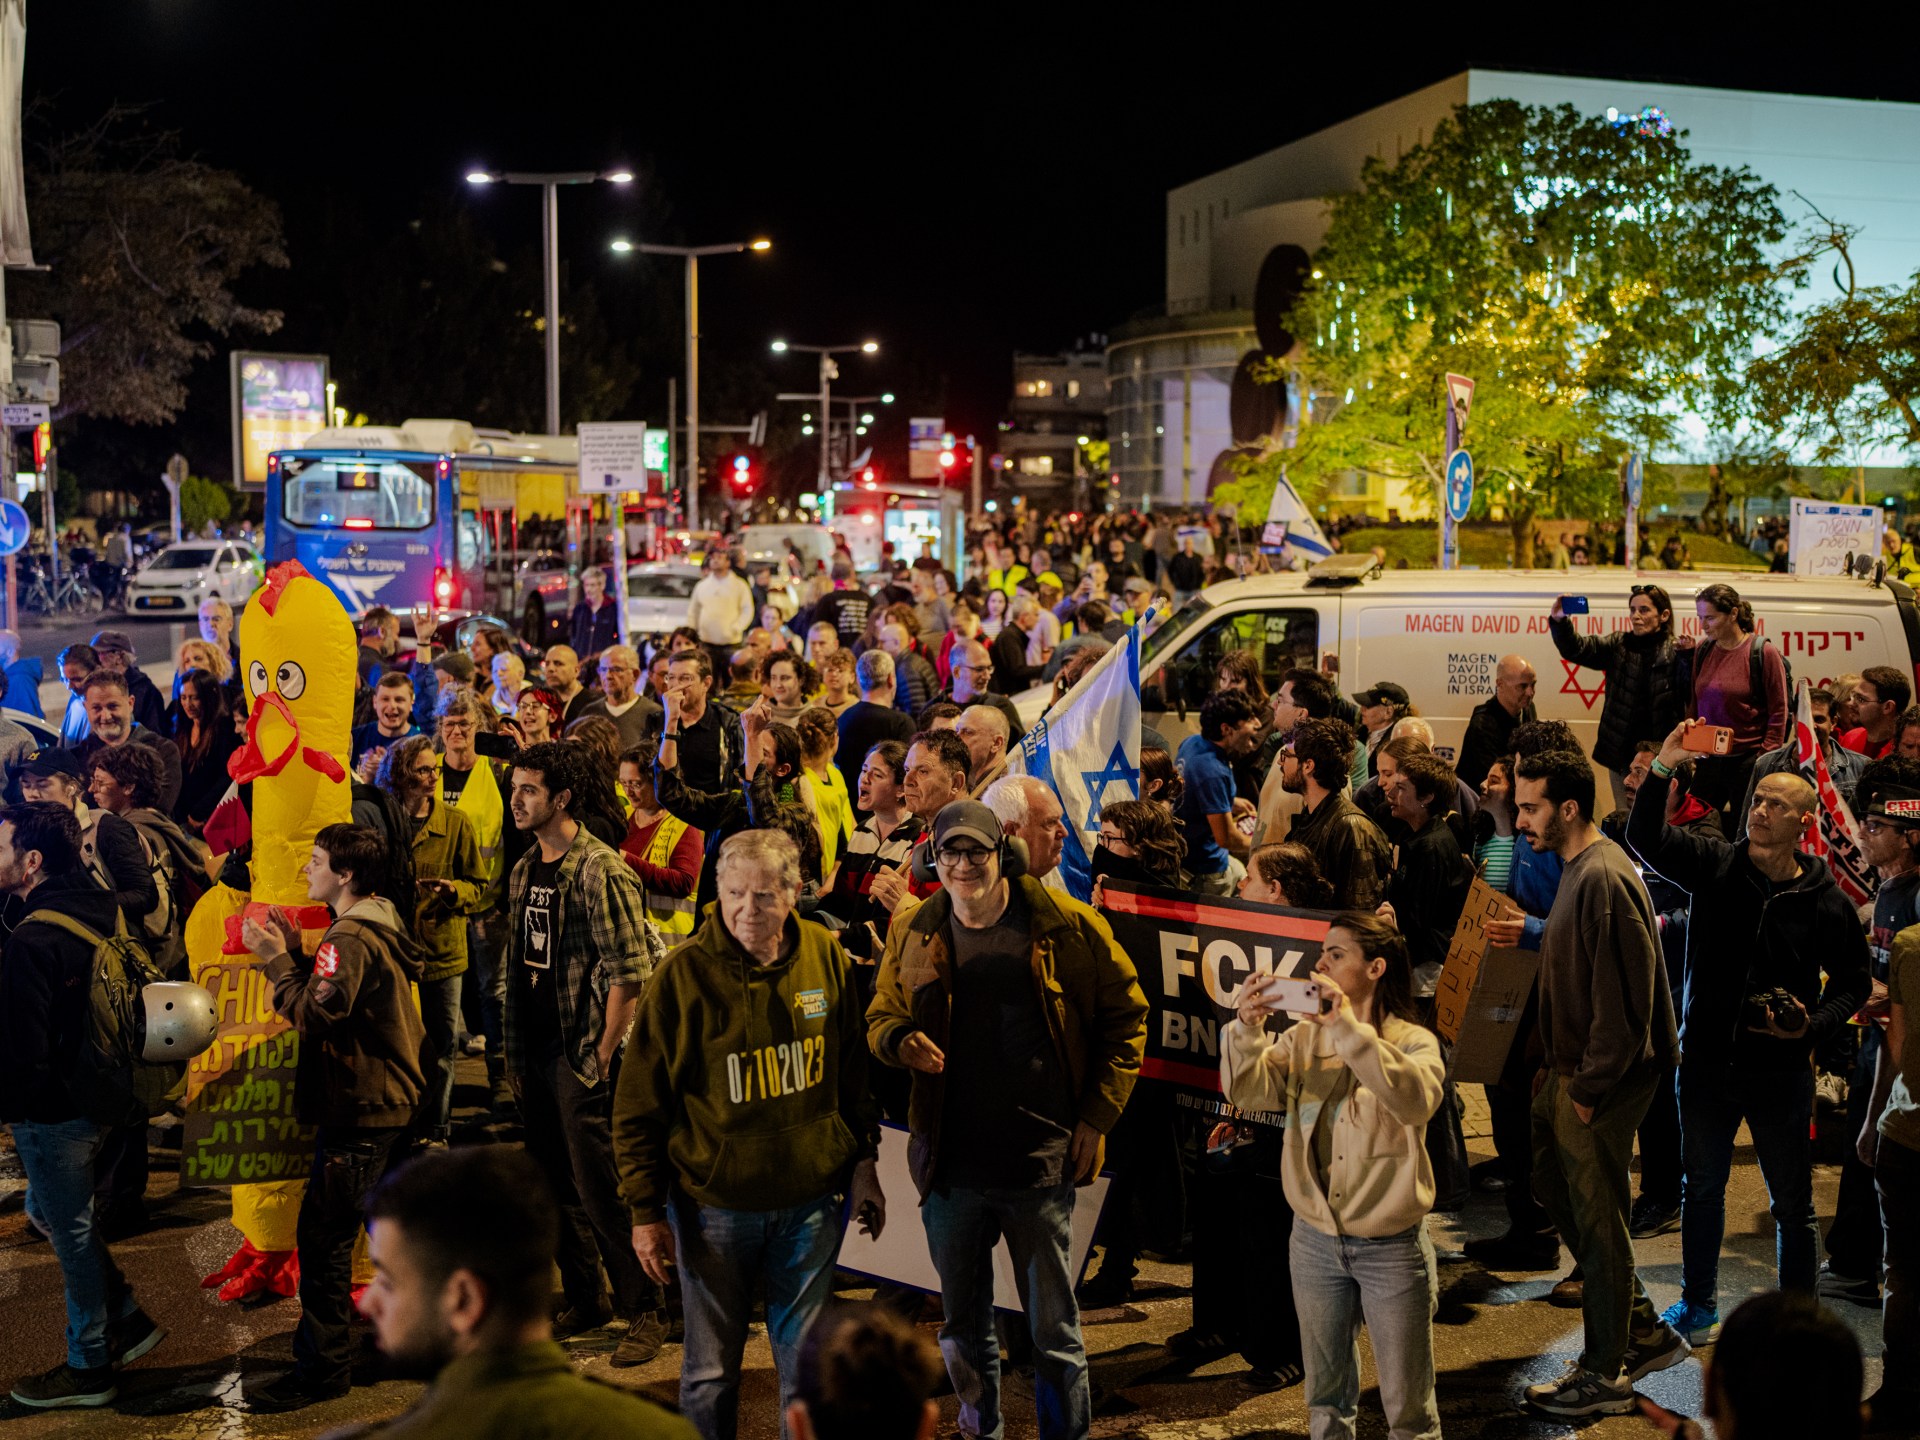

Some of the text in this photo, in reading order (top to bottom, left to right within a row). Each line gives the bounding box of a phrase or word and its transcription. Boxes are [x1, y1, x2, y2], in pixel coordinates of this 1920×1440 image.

[1405, 614, 1464, 633] MAGEN
[1472, 615, 1510, 634] DAVID
[1526, 616, 1578, 634] ADM
[1587, 616, 1603, 634] IN
[1781, 631, 1864, 656] ירקון
[1448, 653, 1497, 663] MAGEN
[1448, 664, 1489, 674] DAVID
[1449, 675, 1490, 684] ADOM
[1448, 685, 1460, 695] IN
[1886, 800, 1920, 811] CRI
[1159, 930, 1304, 1021] FCK
[199, 965, 284, 1024] CHIC
[727, 1035, 825, 1104] 07102023
